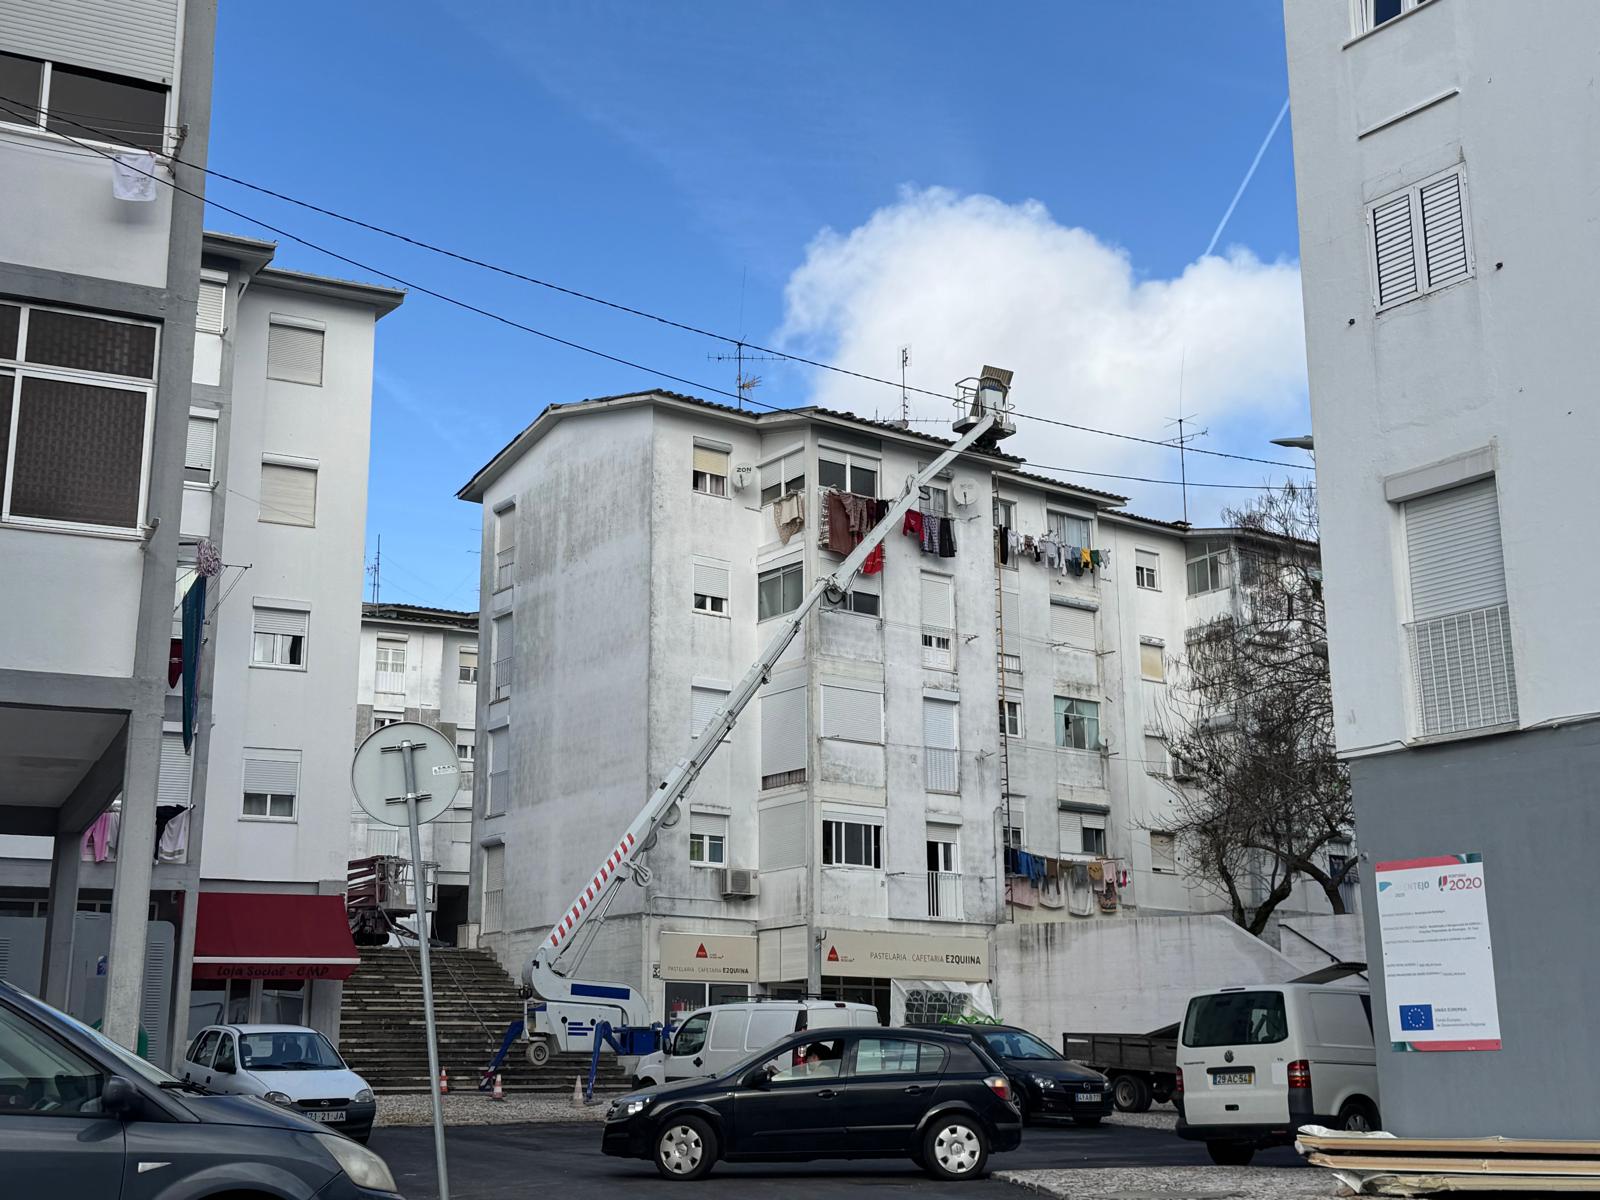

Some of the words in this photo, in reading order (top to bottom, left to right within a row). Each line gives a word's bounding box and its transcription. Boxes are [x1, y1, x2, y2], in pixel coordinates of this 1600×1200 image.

[1449, 877, 1482, 891] 2020
[869, 951, 907, 961] PASTELARIA
[217, 966, 243, 977] Loja
[246, 966, 286, 977] Social
[296, 966, 329, 977] CMP
